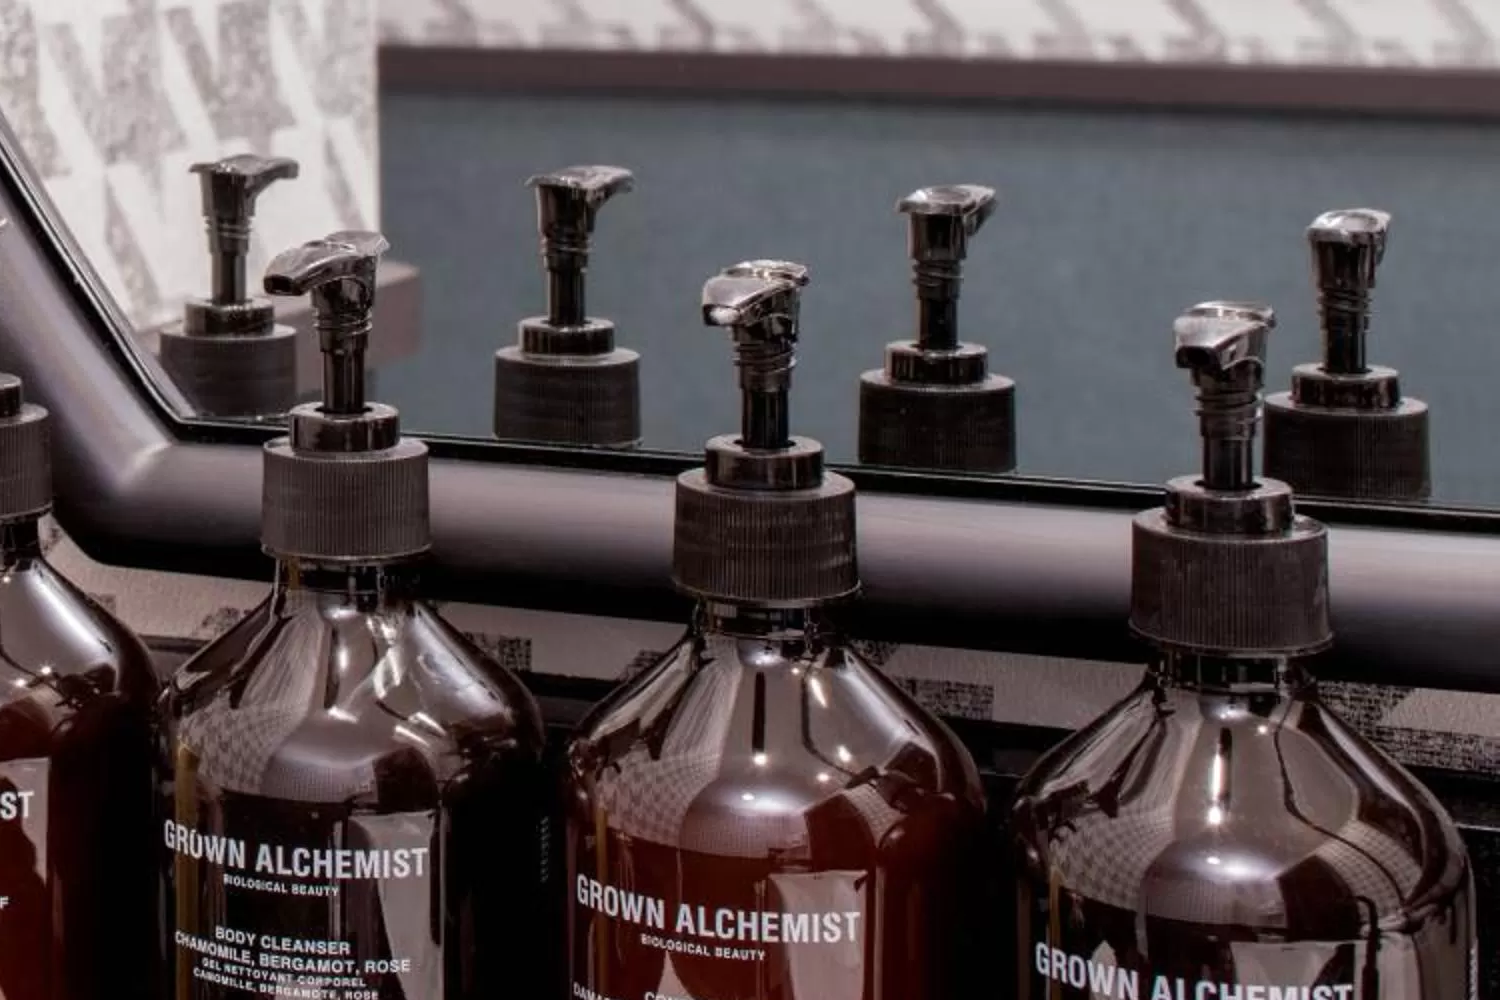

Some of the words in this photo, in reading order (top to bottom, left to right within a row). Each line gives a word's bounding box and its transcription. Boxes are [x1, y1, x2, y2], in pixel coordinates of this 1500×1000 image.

[164, 819, 245, 869] GROWN
[255, 844, 428, 878] ALCHEMIST
[223, 873, 287, 893] BIOLOGICAL
[292, 884, 340, 896] BEAUTY
[577, 873, 664, 929] GROWN
[676, 903, 860, 943] ALCHEMIST
[175, 932, 254, 965] CHAMOMILE,
[260, 954, 360, 975] BERGAMOT,
[365, 959, 411, 973] ROSE
[215, 925, 256, 947] BODY
[261, 935, 350, 955] CLEANSER
[640, 933, 710, 956] BIOLOGICAL
[715, 947, 766, 961] BEAUTY
[202, 957, 221, 971] GEL
[224, 963, 293, 983] NETTOYANT
[297, 975, 367, 987] CORPOREL
[345, 991, 379, 1000] ROSE
